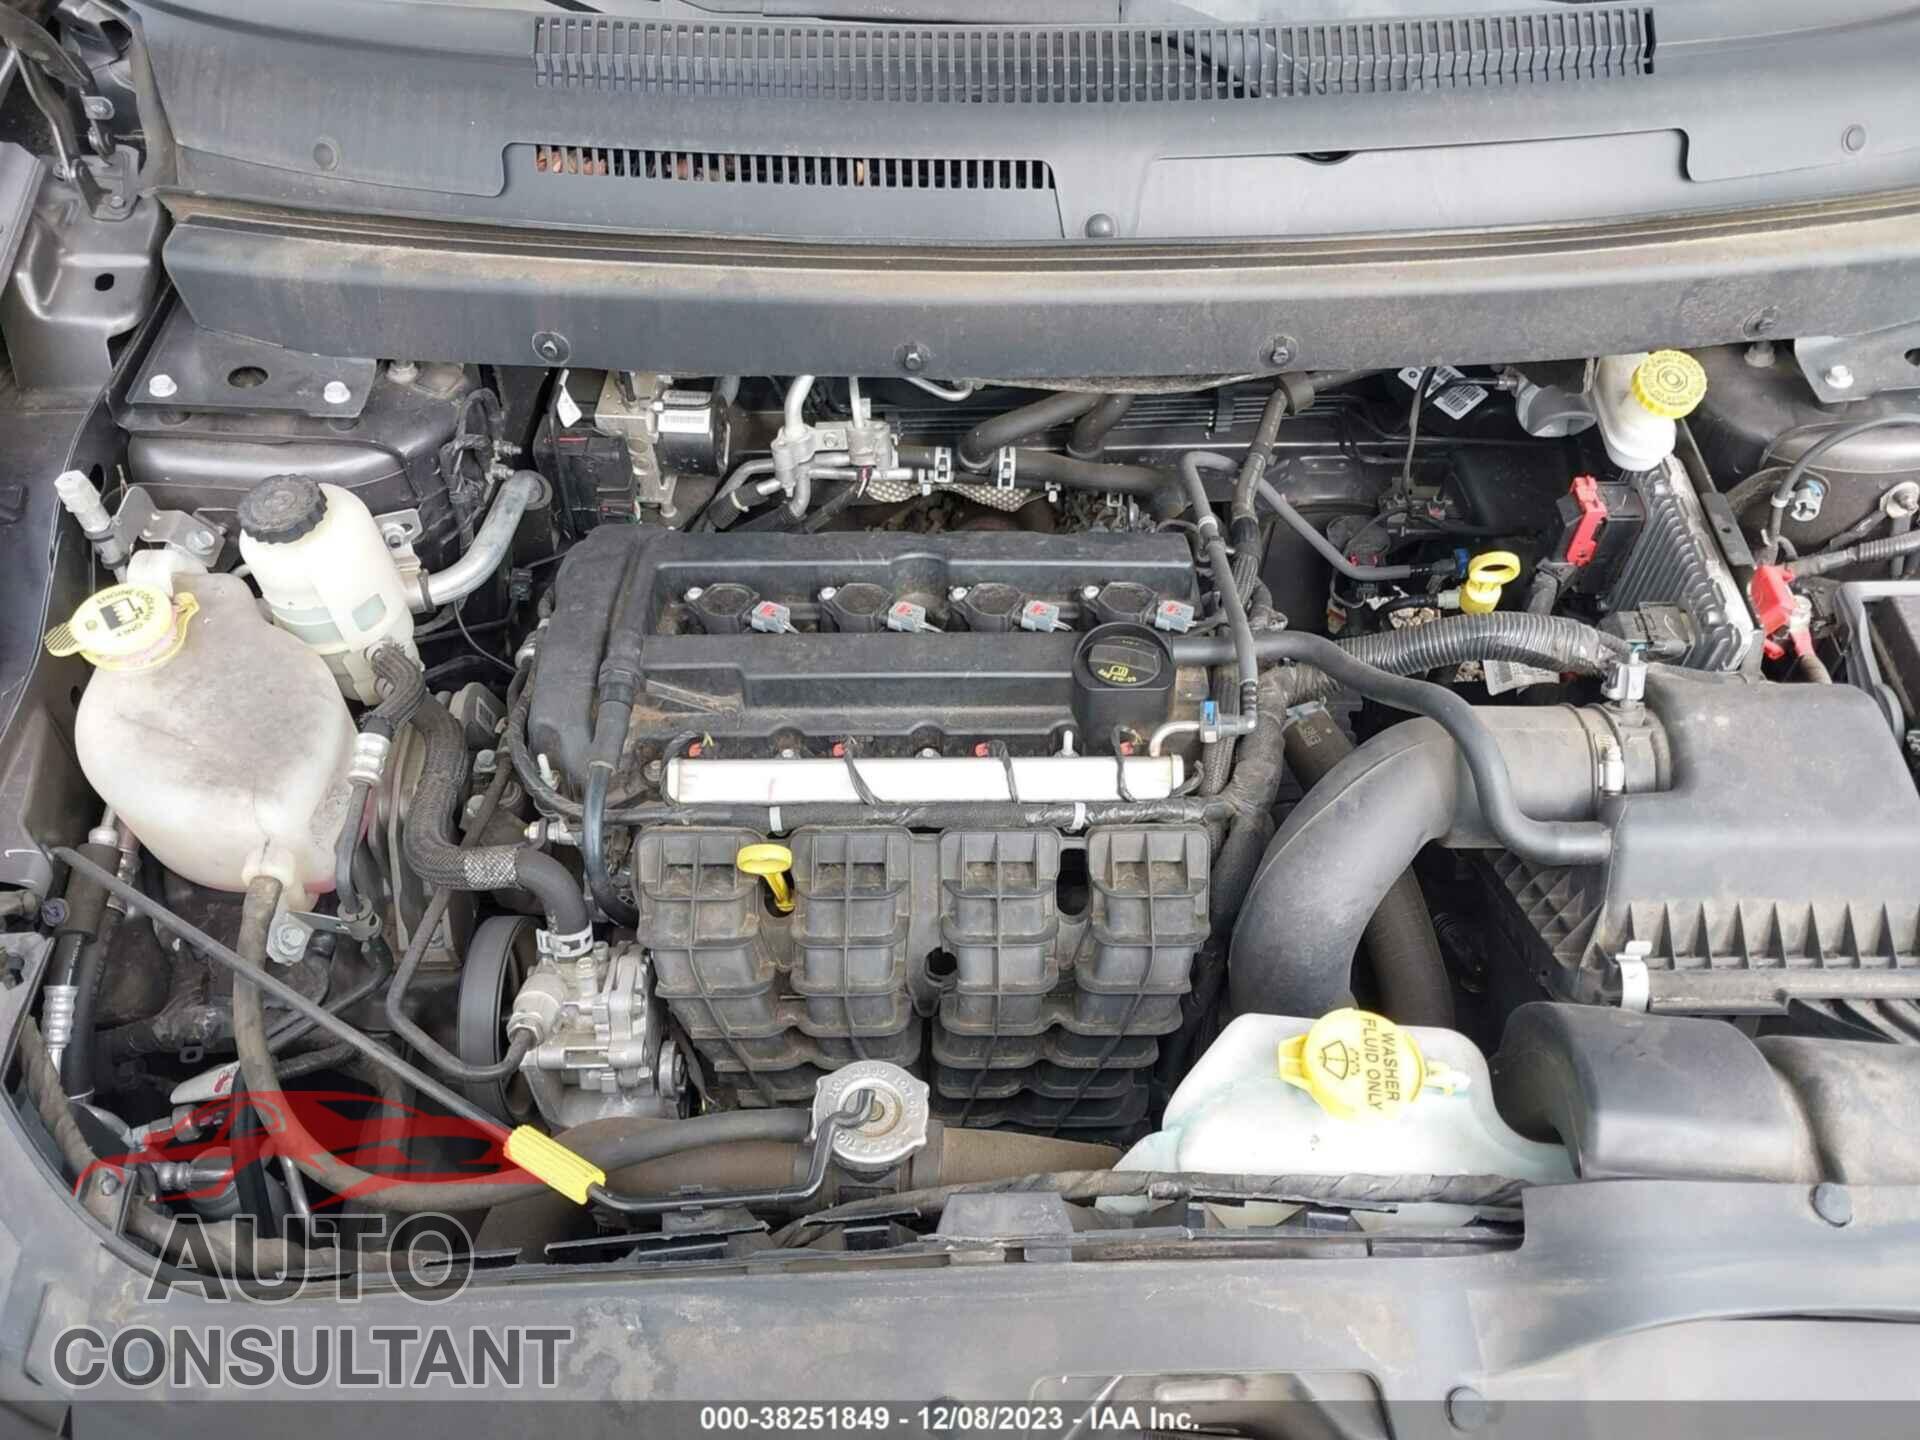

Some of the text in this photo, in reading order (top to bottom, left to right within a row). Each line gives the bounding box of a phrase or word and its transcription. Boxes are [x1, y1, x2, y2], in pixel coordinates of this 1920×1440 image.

[96, 589, 133, 604] ENGINE
[1363, 1018, 1382, 1110] FLUID ONLY
[1382, 1033, 1400, 1101] WASHER
